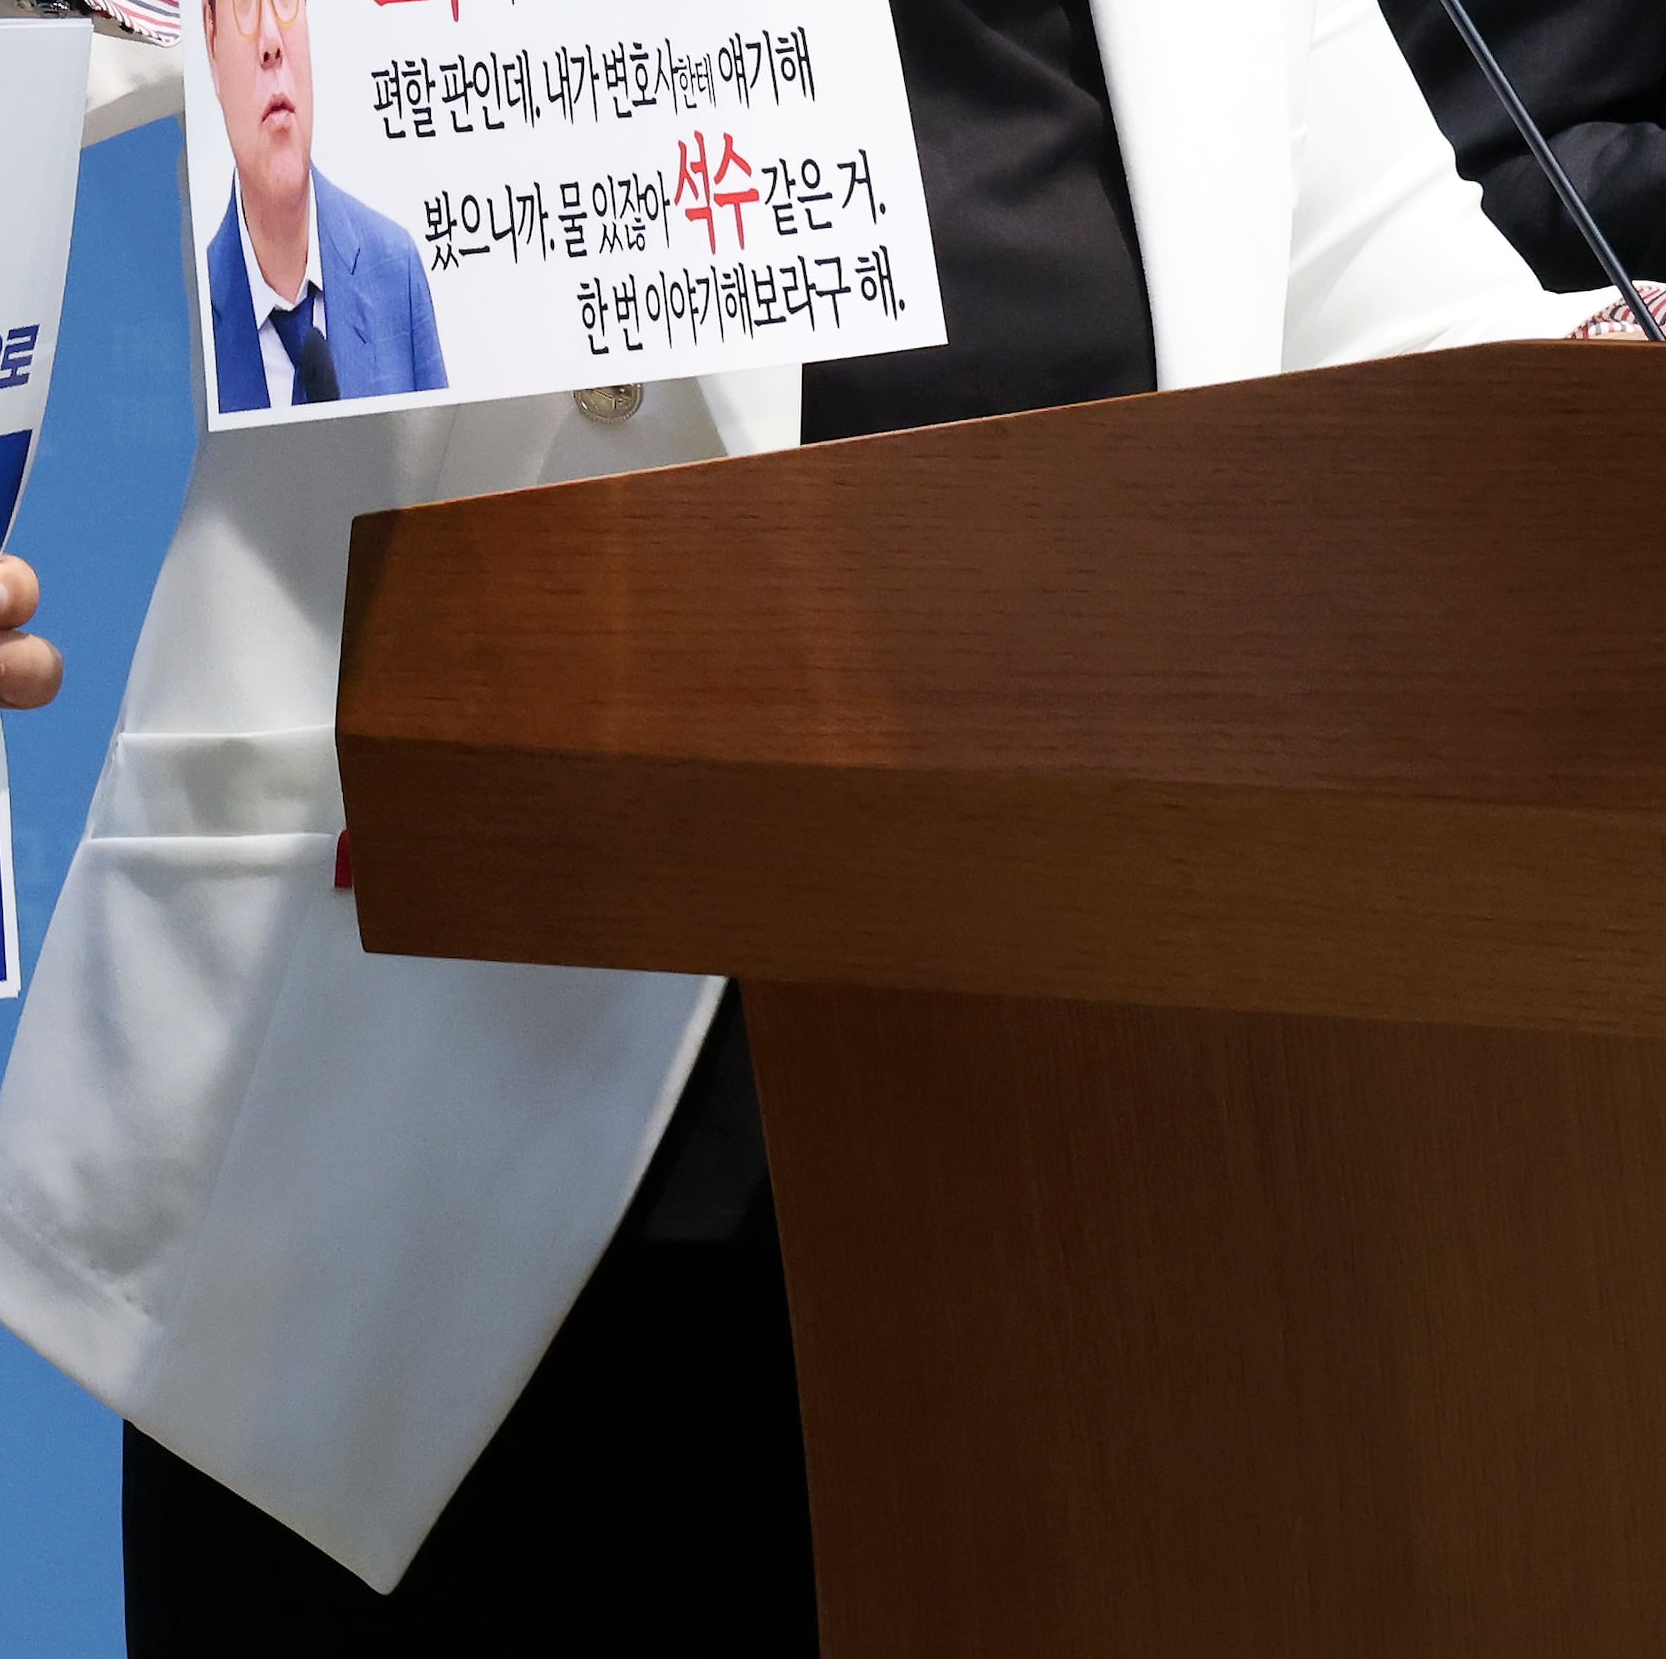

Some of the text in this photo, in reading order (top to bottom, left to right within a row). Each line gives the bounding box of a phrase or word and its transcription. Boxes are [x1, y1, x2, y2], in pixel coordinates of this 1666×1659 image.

[371, 26, 816, 139] 편할 판인데. 내가 변호사한테 얘기해
[424, 130, 886, 272] 봤으니까. 물 있잖아 석수 같은 거.
[577, 276, 610, 355] 한
[612, 273, 644, 352] 번
[854, 245, 906, 321] 해.
